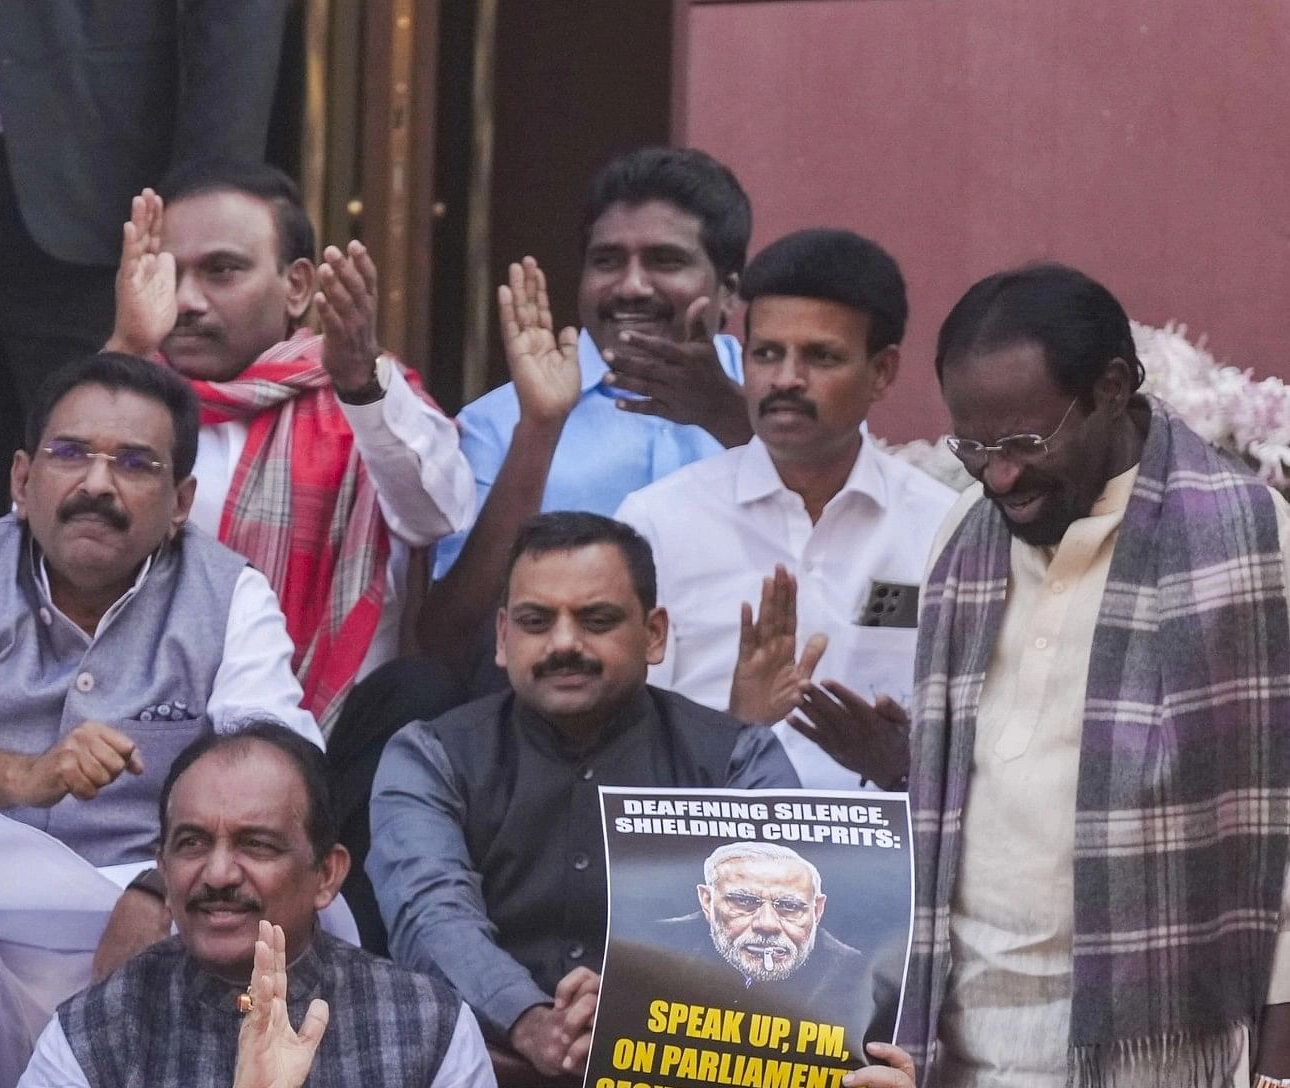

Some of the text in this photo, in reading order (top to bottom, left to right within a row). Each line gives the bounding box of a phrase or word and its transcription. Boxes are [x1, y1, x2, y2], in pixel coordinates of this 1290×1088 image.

[623, 799, 889, 826] DEAFENING SILENCE,
[615, 817, 901, 849] SHIELDING CULPRITS:
[647, 999, 850, 1062] SPEAK UP, PM,
[612, 1038, 656, 1074] ON
